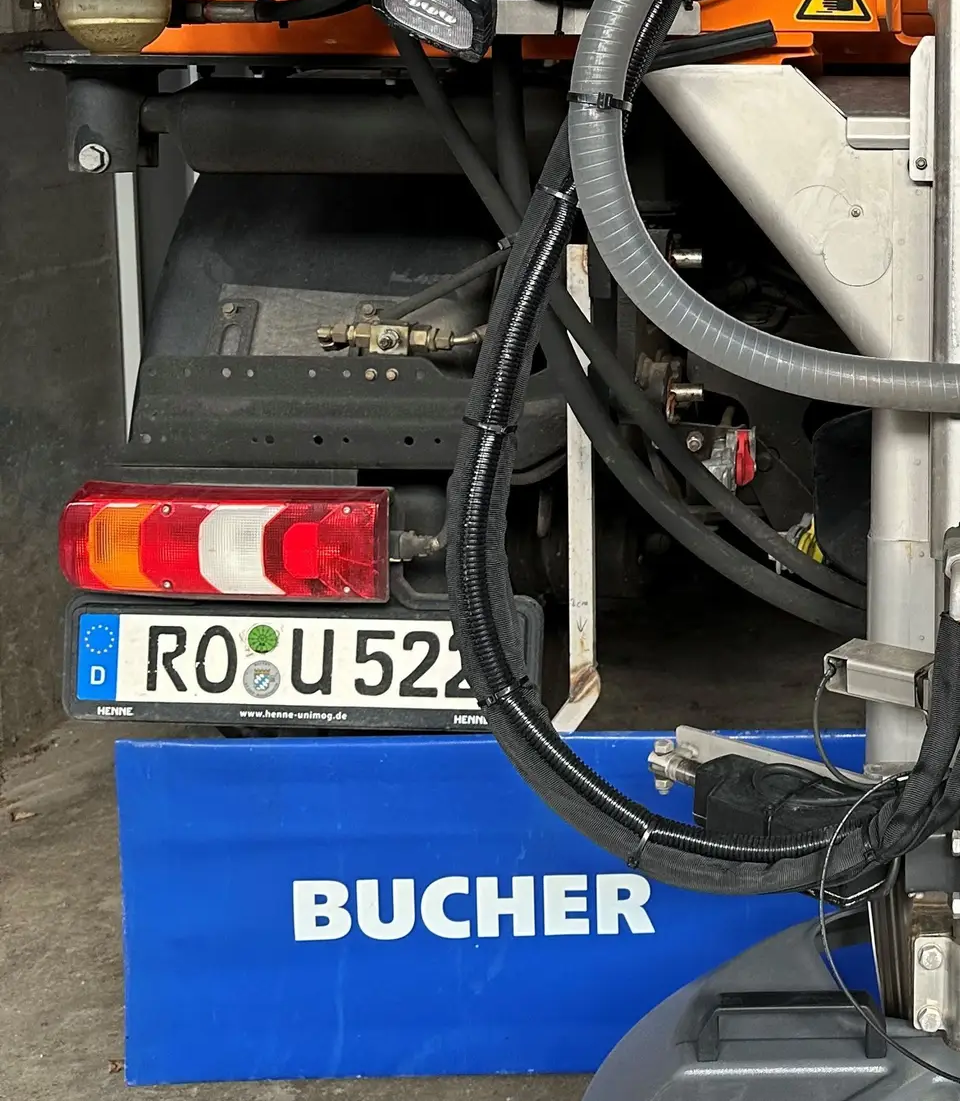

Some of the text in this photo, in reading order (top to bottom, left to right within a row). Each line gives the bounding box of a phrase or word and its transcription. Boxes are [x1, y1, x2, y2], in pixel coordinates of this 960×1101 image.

[90, 666, 105, 686] D
[146, 625, 238, 695] RO
[97, 706, 489, 725] HENNE www.henne-unimog.de HENN
[293, 873, 655, 942] BUCHER
